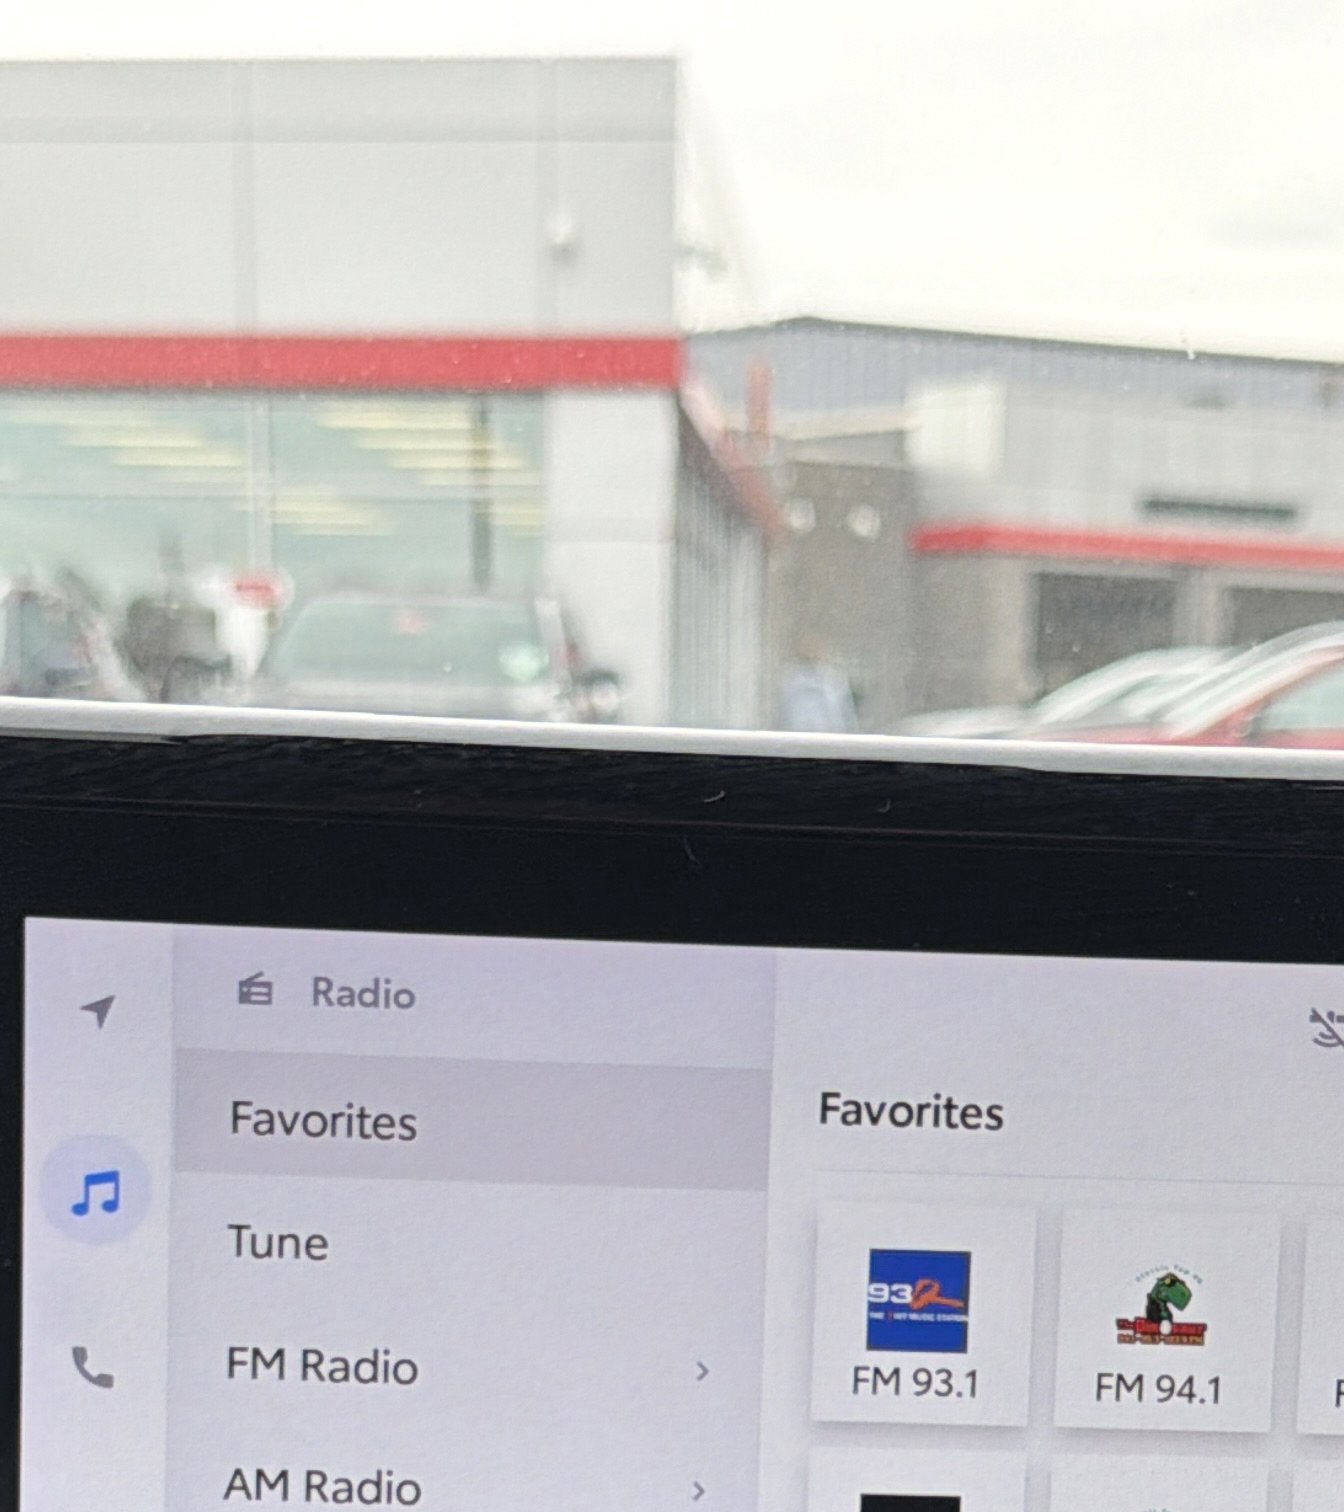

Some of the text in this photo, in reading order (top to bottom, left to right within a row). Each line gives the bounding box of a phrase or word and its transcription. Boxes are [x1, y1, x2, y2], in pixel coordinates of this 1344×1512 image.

[312, 975, 416, 1010] Radio
[231, 1100, 417, 1142] Favorites
[819, 1091, 1004, 1131] Favorites
[227, 1223, 329, 1261] Tune
[227, 1346, 419, 1386] FM Radio
[852, 1365, 977, 1399] FM 93.1
[1095, 1372, 1220, 1405] FM 94.1
[223, 1467, 422, 1506] AM Radio
